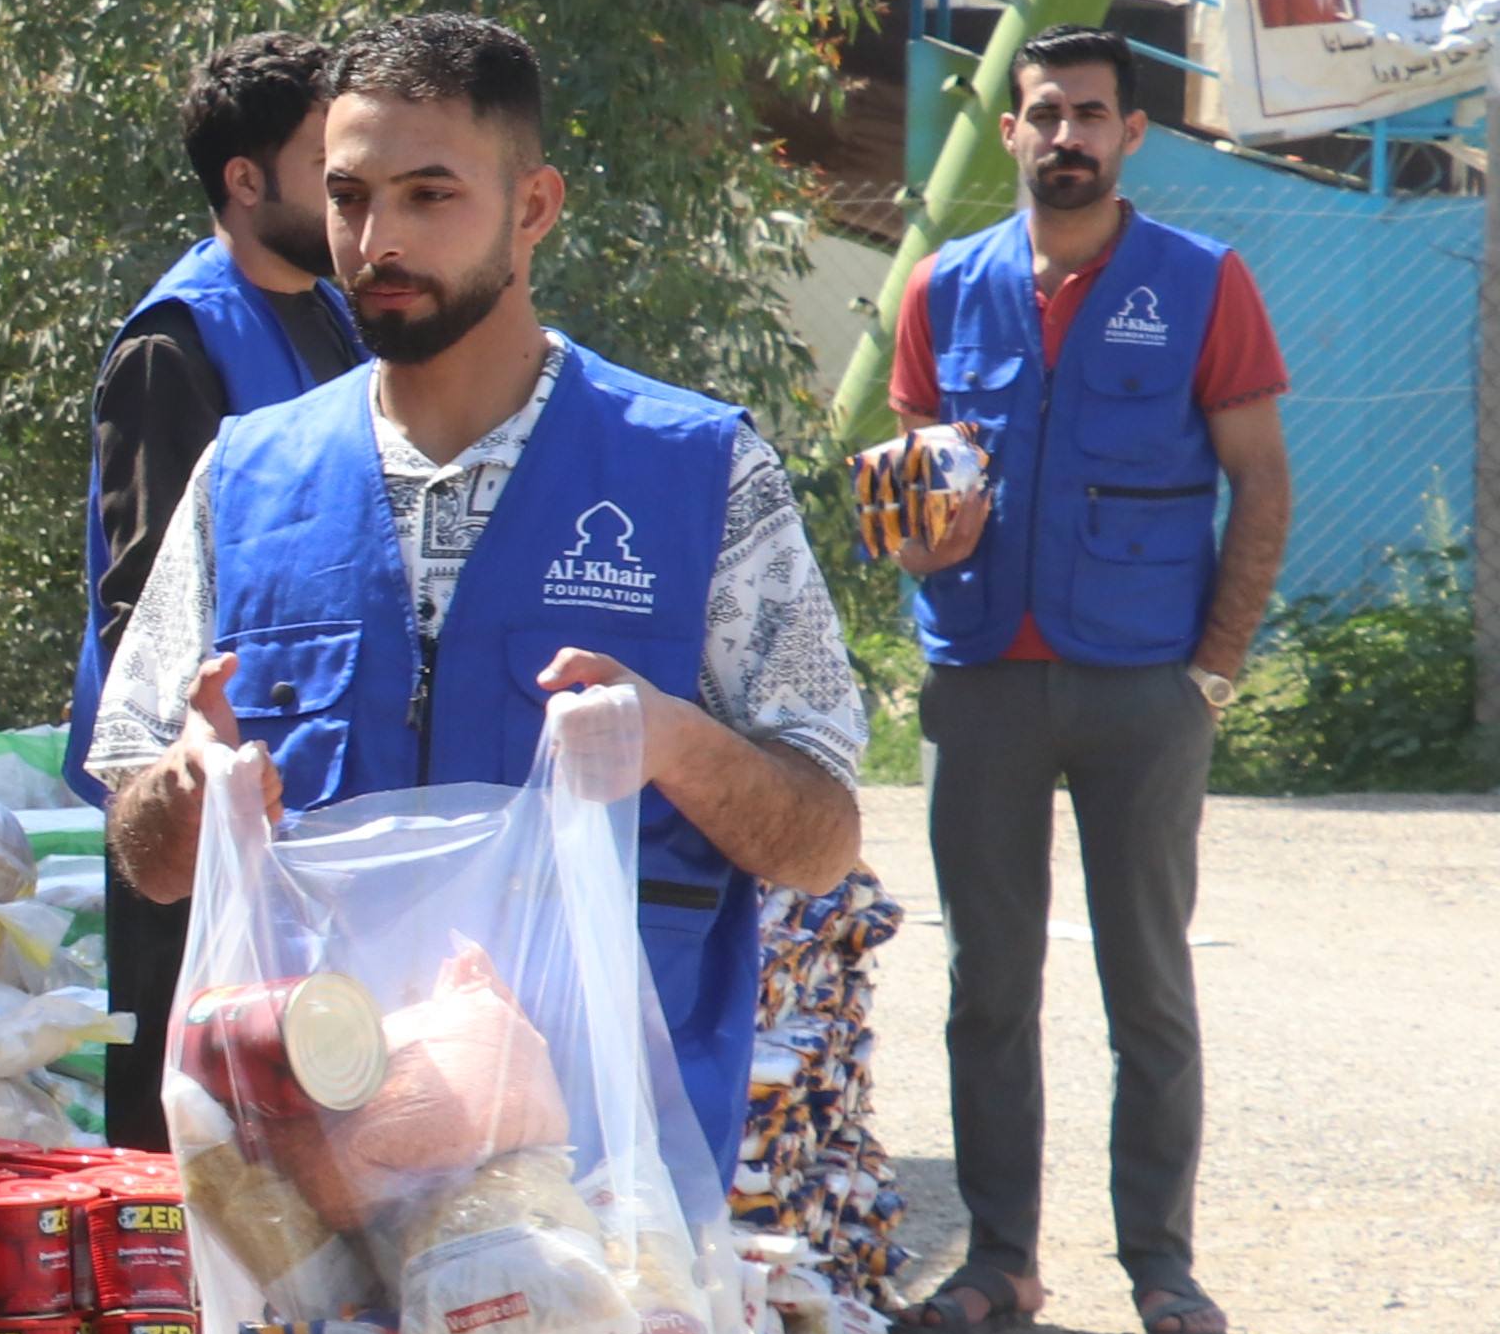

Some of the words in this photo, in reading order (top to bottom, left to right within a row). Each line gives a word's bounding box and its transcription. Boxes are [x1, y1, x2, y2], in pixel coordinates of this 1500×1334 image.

[544, 559, 656, 588] Al-Khair
[544, 584, 654, 604] FOUNDATION
[135, 1205, 183, 1231] ZER
[446, 1293, 529, 1333] Vermicelli
